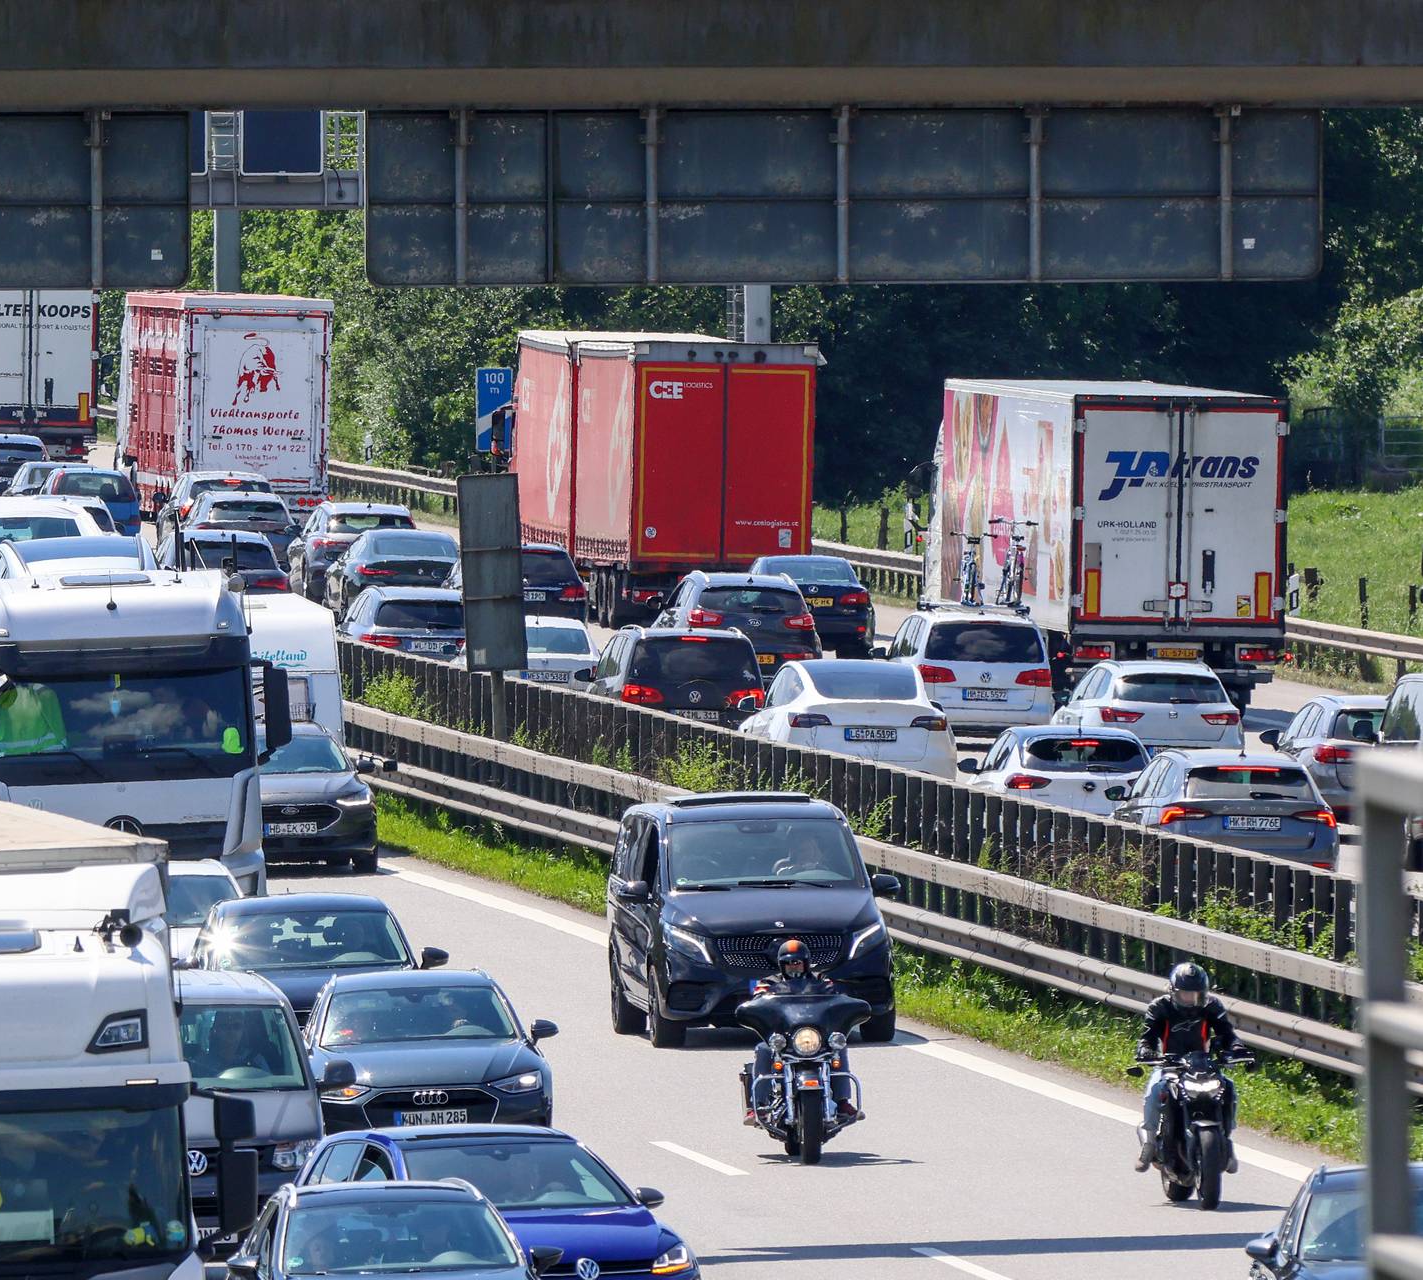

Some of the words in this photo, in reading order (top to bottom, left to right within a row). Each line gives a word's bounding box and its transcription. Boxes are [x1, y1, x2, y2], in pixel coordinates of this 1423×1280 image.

[37, 304, 91, 318] KOOPS
[485, 373, 505, 384] 100
[649, 381, 683, 399] CEE
[210, 408, 300, 420] Viehtransporte
[212, 425, 258, 436] Thomas
[263, 426, 305, 437] Werner
[208, 442, 224, 451] Tel.
[237, 443, 252, 451] 170
[262, 444, 273, 452] 47
[277, 444, 286, 452] 14
[1097, 520, 1157, 529] URK-HOLLAND
[849, 729, 861, 739] LG
[864, 729, 875, 739] PA
[1229, 817, 1240, 827] HK
[1258, 817, 1280, 828] 776E
[269, 823, 281, 834] HB
[286, 823, 298, 833] EK
[300, 823, 316, 832] 293
[430, 1112, 444, 1125] AH
[446, 1111, 466, 1124] 285
